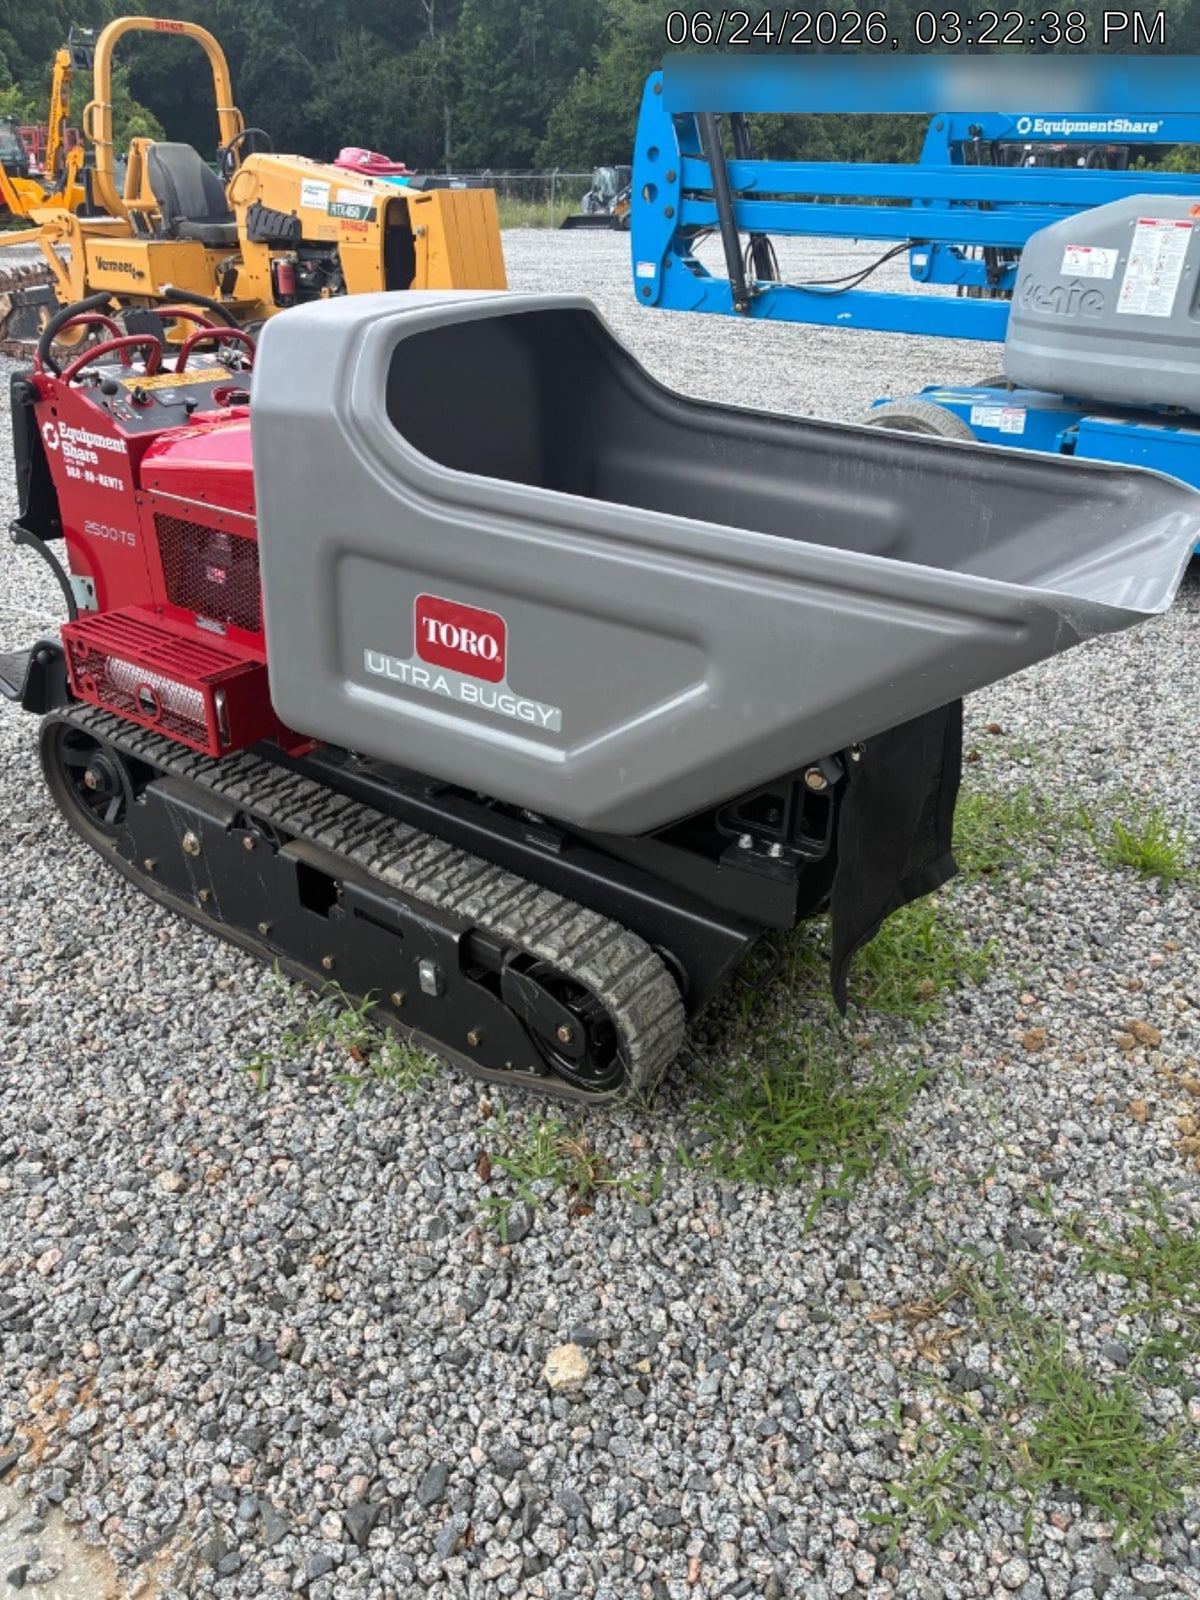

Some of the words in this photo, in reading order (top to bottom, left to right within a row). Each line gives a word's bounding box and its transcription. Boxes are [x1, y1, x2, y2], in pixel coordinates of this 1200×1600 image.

[1033, 118, 1159, 136] EquipmentShare
[95, 254, 133, 274] Vermeer
[58, 421, 128, 454] Equipment
[62, 440, 99, 465] Share
[422, 616, 501, 661] TORO
[367, 652, 452, 696] ULTRA
[460, 681, 556, 727] BUGGY
